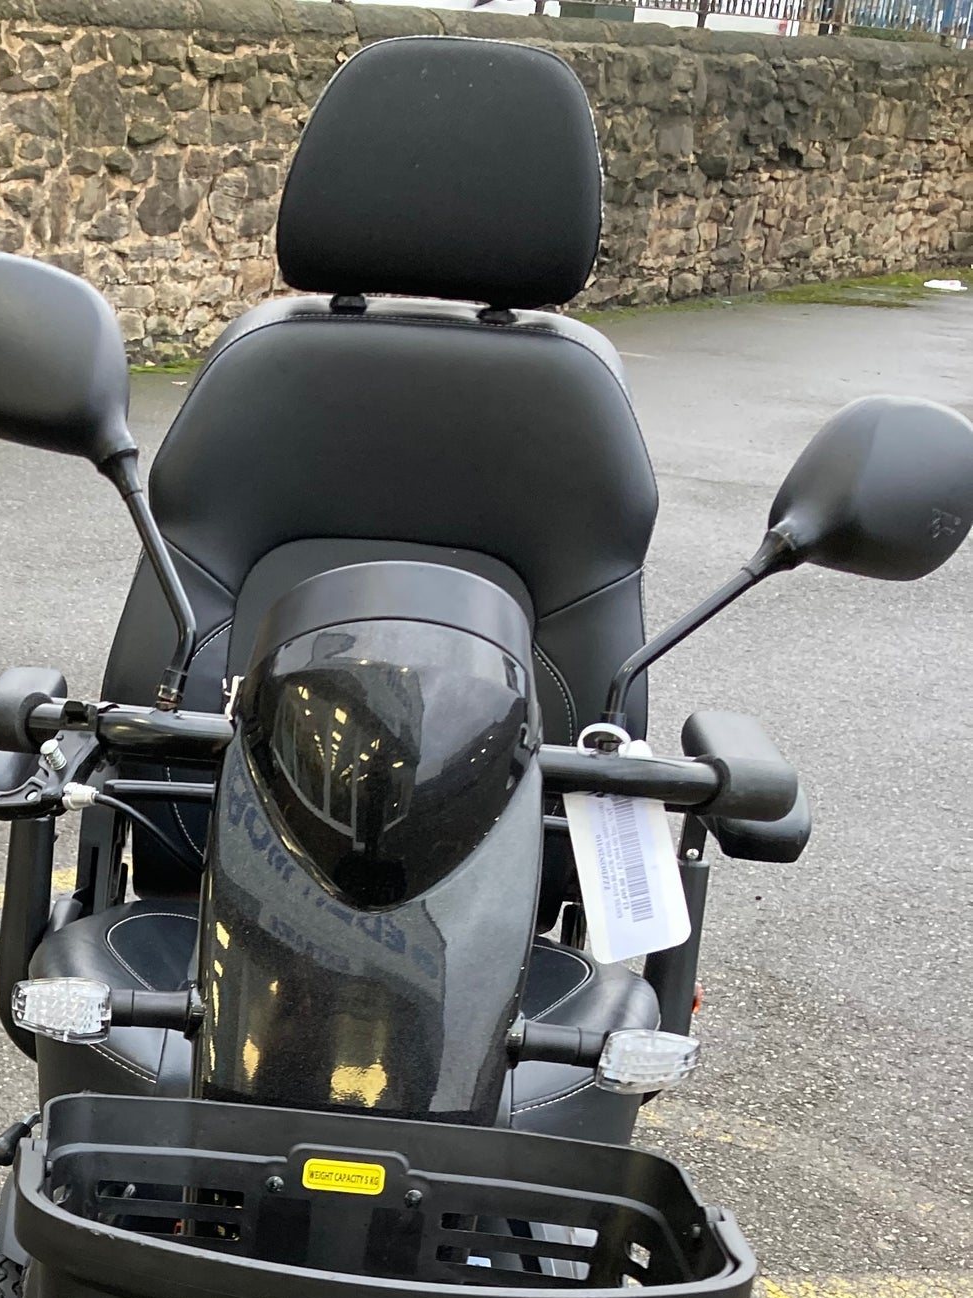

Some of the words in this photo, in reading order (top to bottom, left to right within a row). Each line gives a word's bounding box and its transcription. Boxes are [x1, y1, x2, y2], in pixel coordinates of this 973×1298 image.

[309, 1170, 333, 1181] WEIGHT
[334, 1173, 363, 1184] CAPACITY
[369, 1176, 379, 1186] KG
